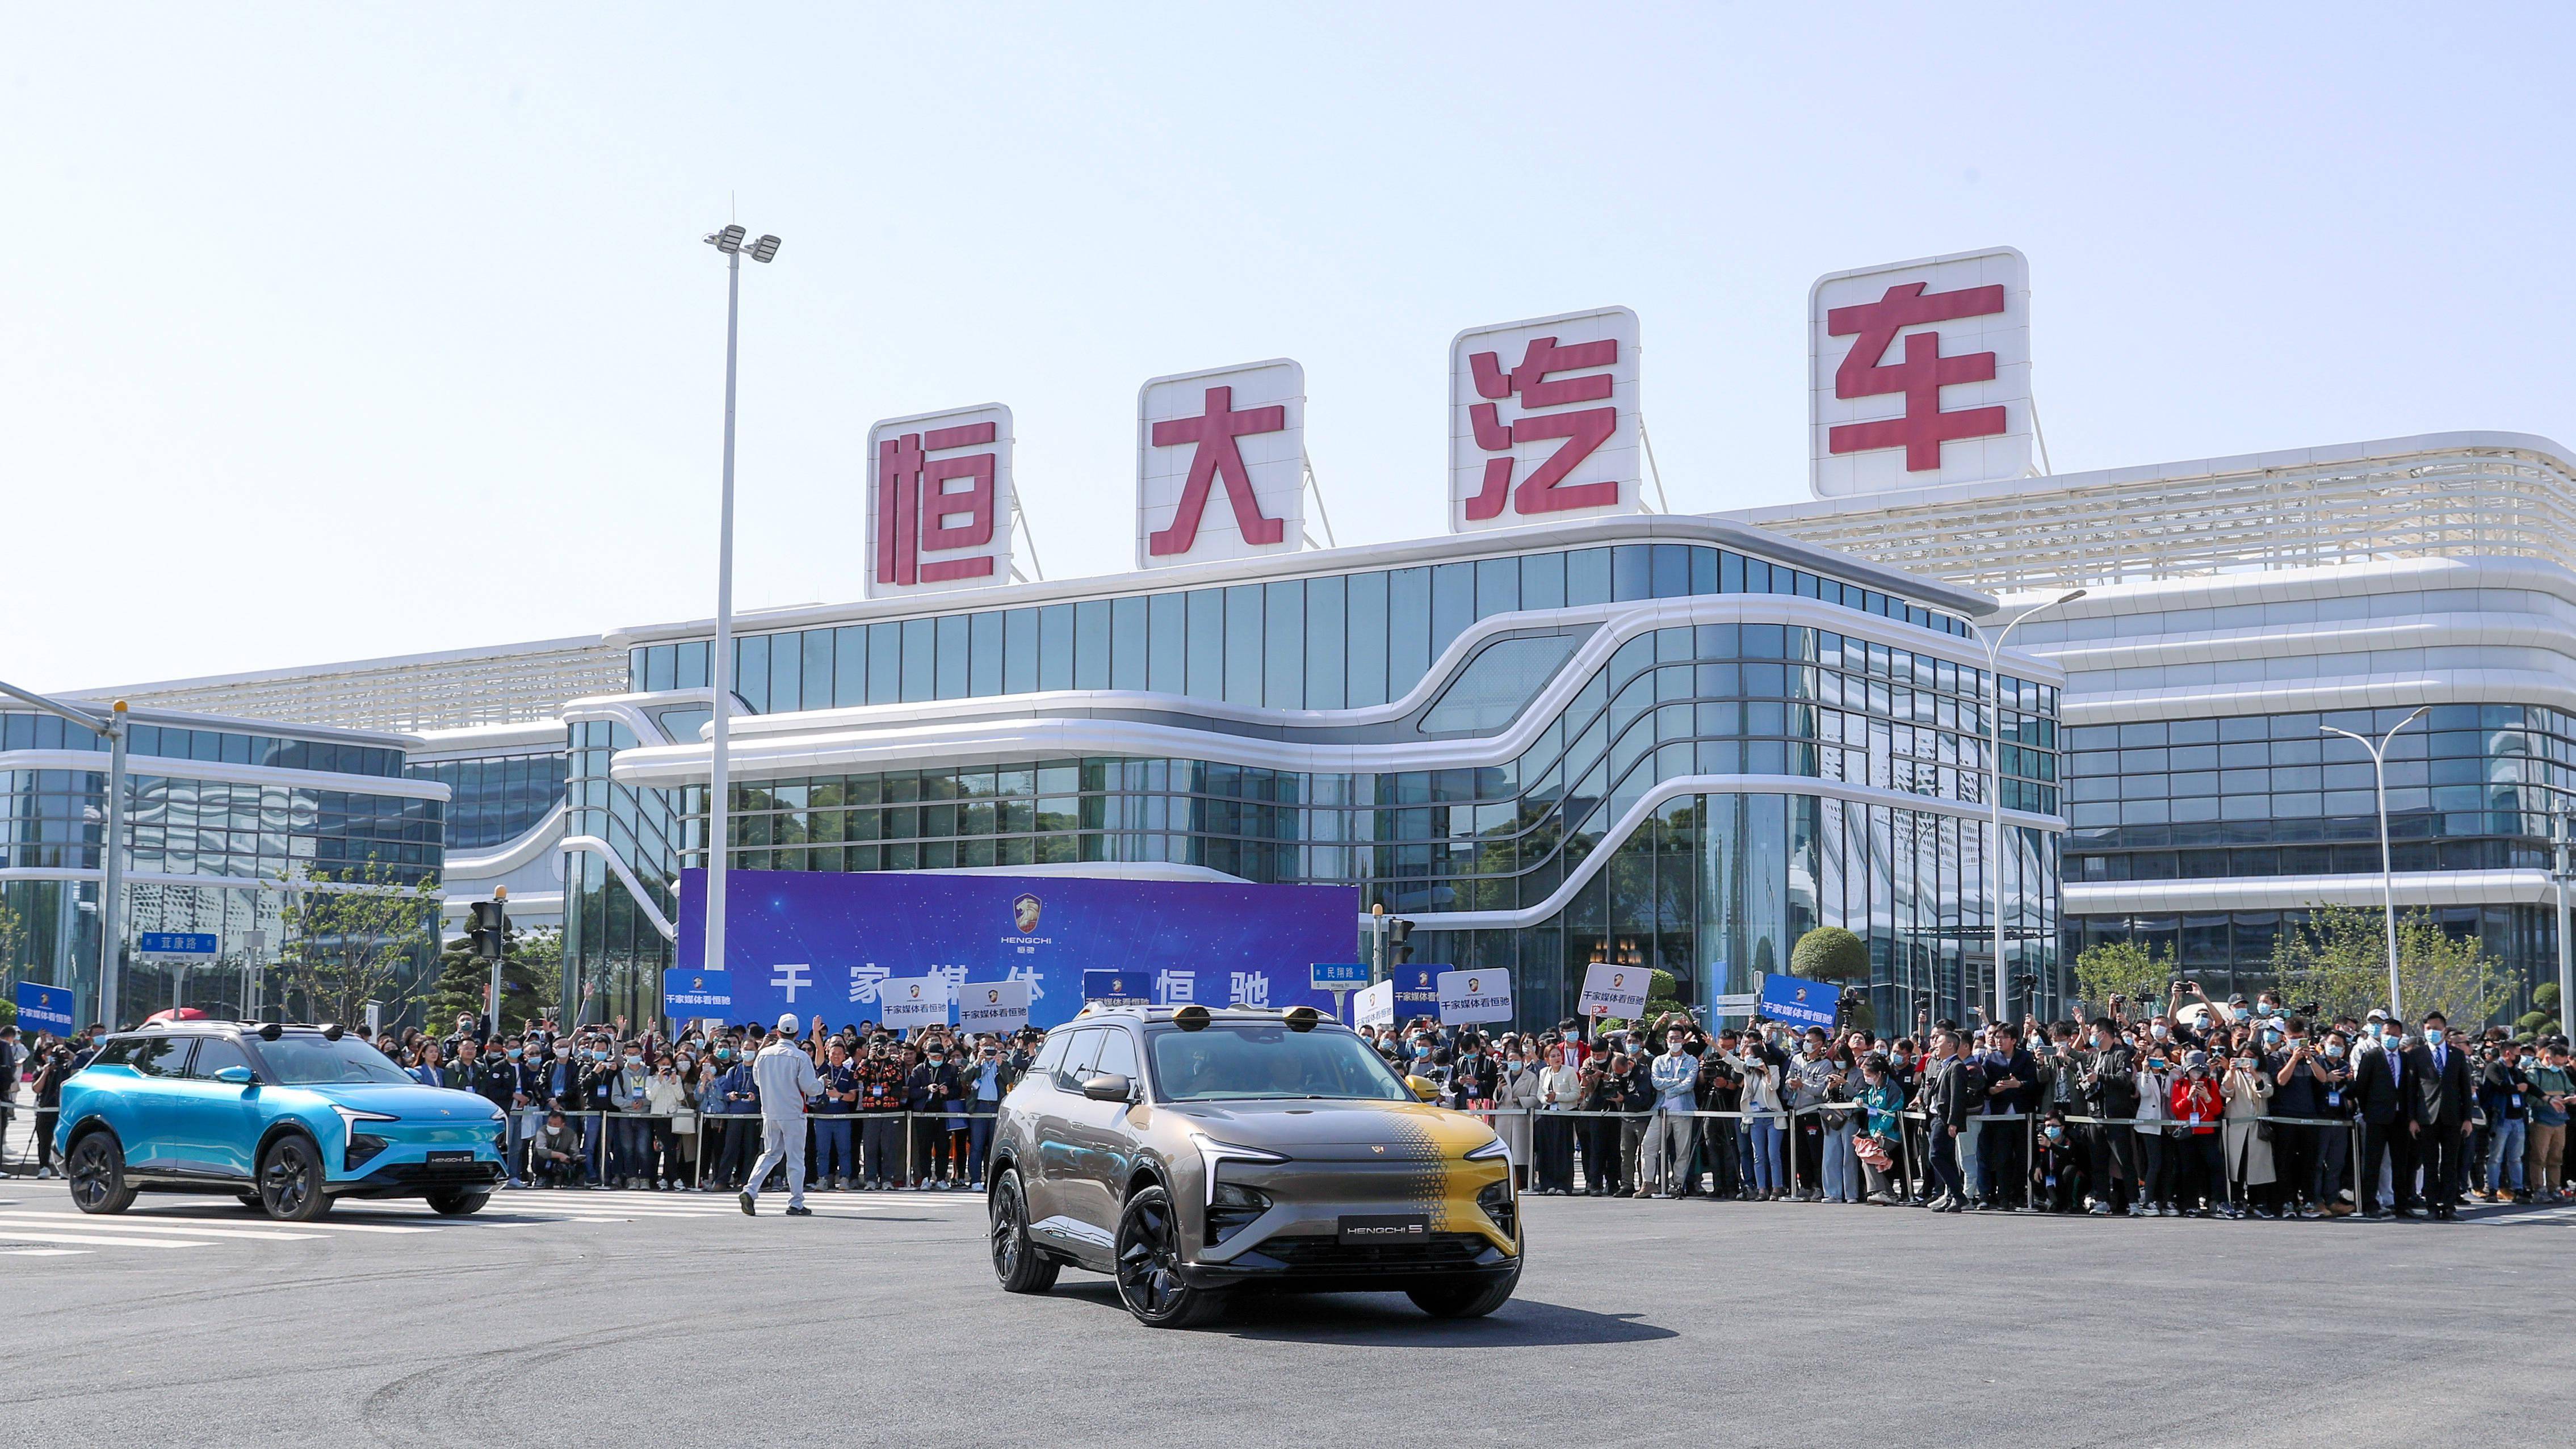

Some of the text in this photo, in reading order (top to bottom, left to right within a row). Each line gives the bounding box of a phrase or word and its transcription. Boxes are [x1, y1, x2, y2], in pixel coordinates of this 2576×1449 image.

[161, 936, 196, 949] 茸康路
[1327, 967, 1353, 978] 民翔路
[770, 963, 1270, 1009] 千家媒体恒驰
[666, 994, 731, 1005] 千家媒体看恒驰
[1441, 996, 1510, 1010] 千家媒体看恒驰
[1584, 990, 1645, 1005] 千家媒体看恒驰
[884, 1003, 947, 1014] 千家媒体看恒驰
[961, 1007, 1027, 1020] 千家媒体看恒驰
[1763, 1001, 1834, 1024] 千家媒体看恒驰
[18, 1007, 72, 1024] 千家媒体看恒驰
[1356, 1006, 1392, 1028] 千家媒体看恒驰
[1408, 1224, 1423, 1233] 5
